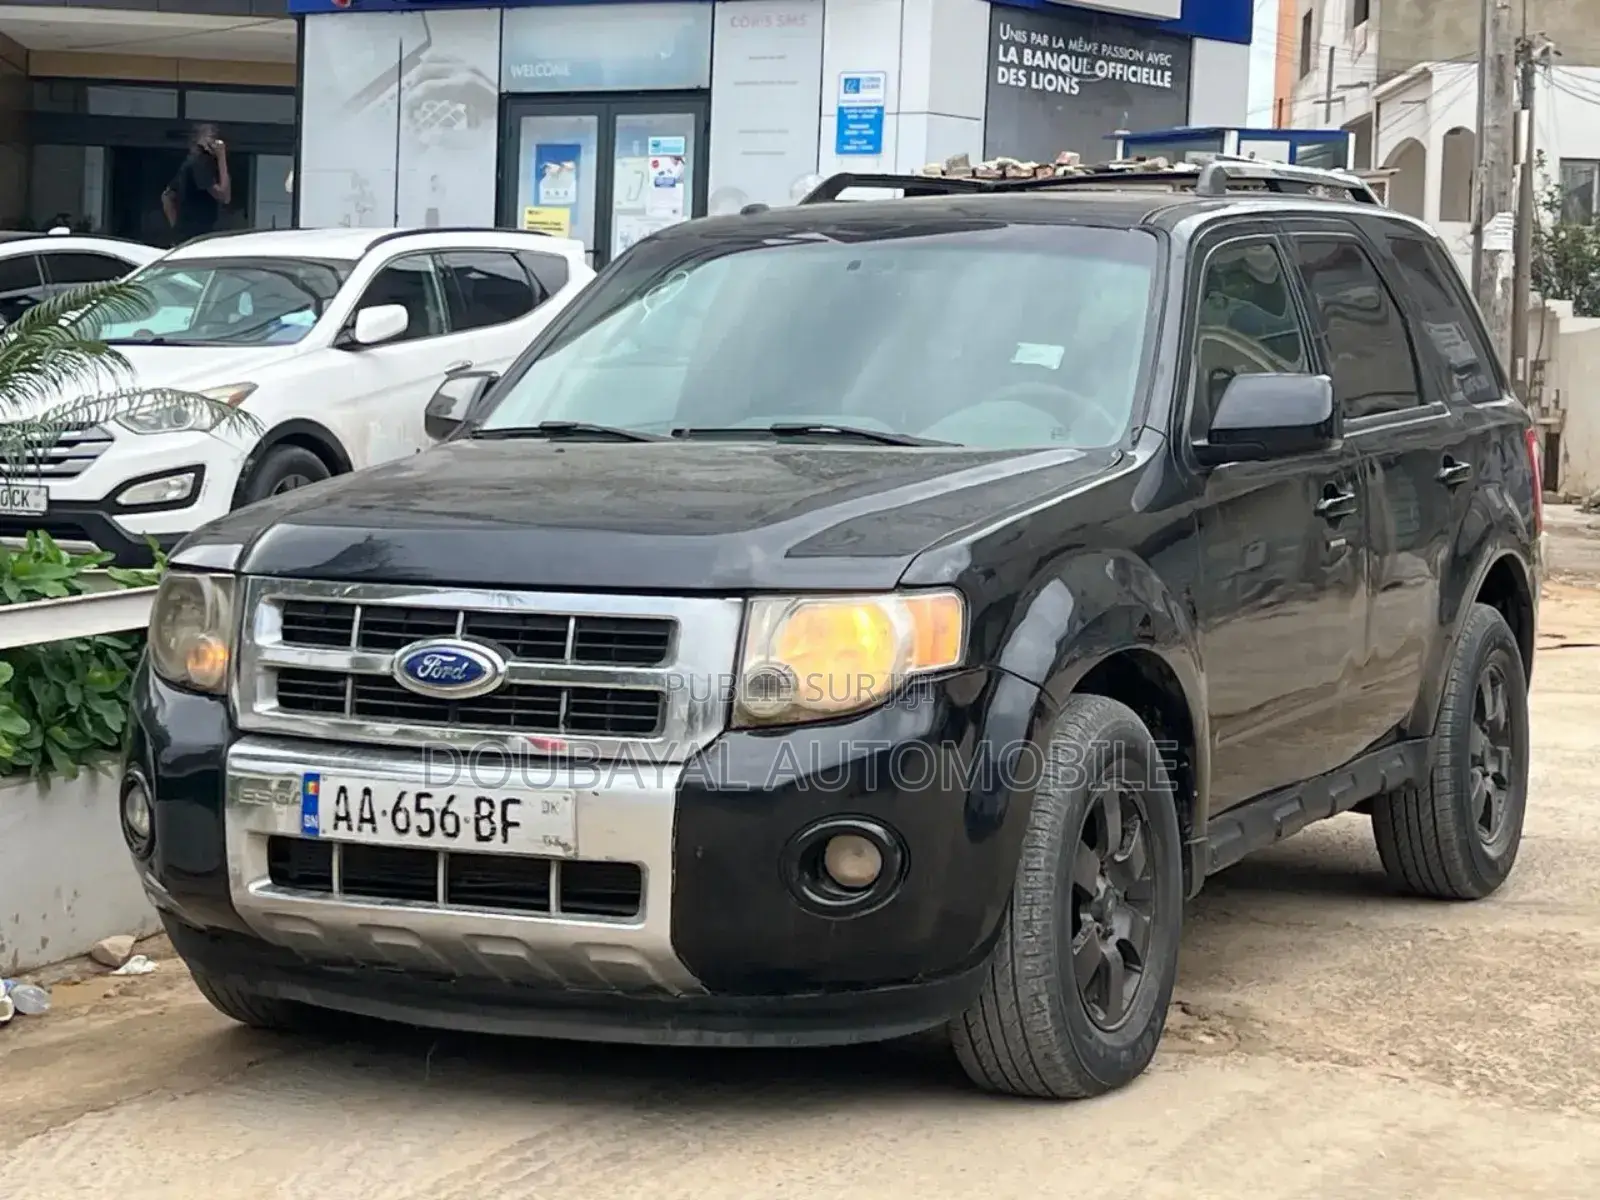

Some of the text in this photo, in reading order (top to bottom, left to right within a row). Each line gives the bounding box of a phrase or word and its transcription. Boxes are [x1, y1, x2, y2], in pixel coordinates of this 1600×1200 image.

[1030, 32, 1049, 47] PAR
[1052, 36, 1065, 50] LA
[1101, 44, 1144, 62] PASSION
[1146, 54, 1172, 67] AVEC
[998, 44, 1172, 88] LA BANQUE OFFICIELLE
[997, 67, 1080, 96] DES LIONS
[417, 654, 469, 680] Ford
[541, 799, 560, 815] DK
[303, 814, 319, 829] SN
